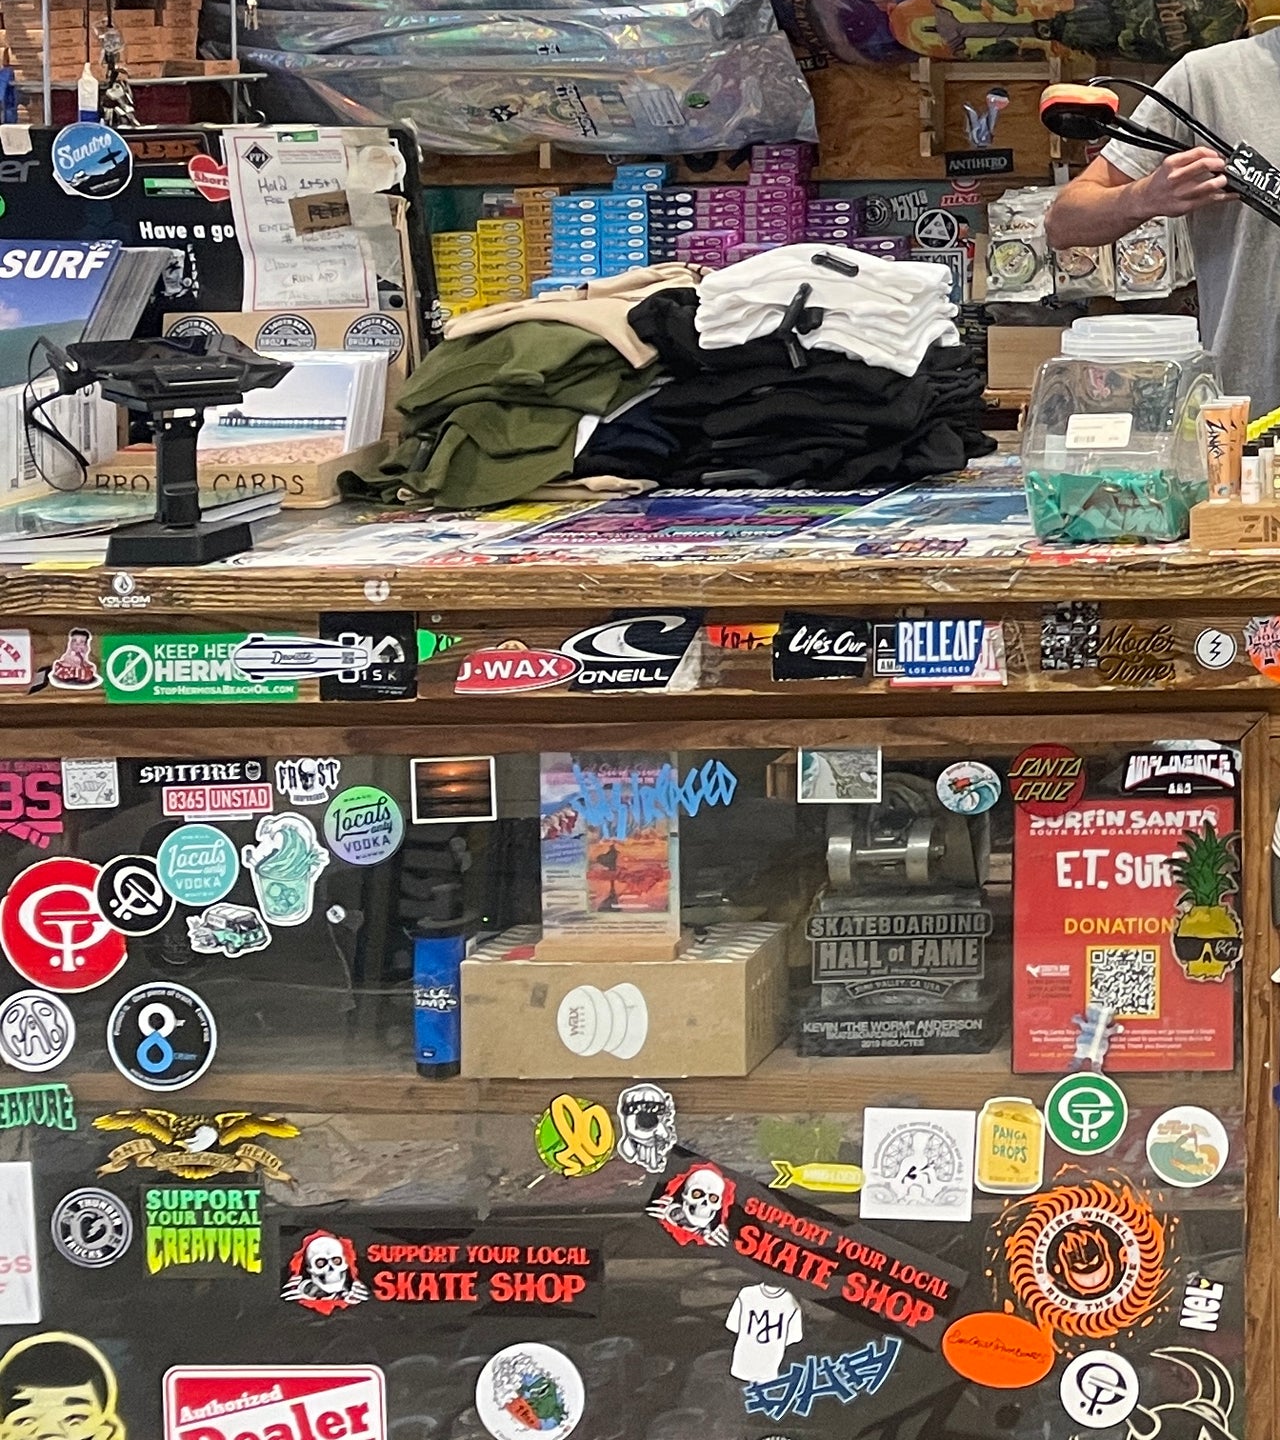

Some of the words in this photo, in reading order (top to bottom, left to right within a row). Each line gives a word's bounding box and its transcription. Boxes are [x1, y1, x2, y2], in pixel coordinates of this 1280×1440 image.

[948, 156, 1008, 171] ANTIHERO
[138, 220, 187, 240] Have
[194, 226, 206, 239] a
[210, 224, 235, 244] go
[3, 243, 119, 279] SURF
[286, 338, 312, 347] PHOTO
[212, 473, 305, 497] CARDS
[98, 595, 150, 605] VOLCOM
[154, 643, 196, 659] KEEP
[898, 620, 982, 662] RELEAF
[908, 665, 924, 674] LOS
[927, 664, 969, 674] ANGELES
[139, 762, 242, 783] SPITFIRE
[1007, 756, 1083, 778] SANTA
[168, 788, 206, 811] 8365
[210, 786, 269, 810] UNSTAD
[1013, 778, 1074, 803] CRUZ
[343, 835, 390, 851] VODKA
[167, 844, 226, 871] Locals
[1056, 849, 1110, 890] E.T.
[176, 877, 222, 888] VODKA
[811, 913, 986, 937] SKATEBOARDING
[820, 941, 882, 969] HALL
[888, 947, 905, 961] of
[910, 939, 979, 967] FAME
[803, 1022, 838, 1032] KEVIN
[917, 1019, 983, 1030] ANDERSON
[990, 1143, 1028, 1165] DROPS
[146, 1189, 257, 1211] SUPPORT
[147, 1211, 197, 1226] YOUR
[202, 1211, 262, 1226] LOCAL
[146, 1226, 262, 1275] CREATURE
[367, 1245, 462, 1265] SUPPORT
[466, 1245, 520, 1266] YOUR
[526, 1245, 590, 1266] LOCAL
[743, 1197, 831, 1247] SUPPORT
[836, 1236, 889, 1274] YOUR
[889, 1257, 950, 1302] LOCAL
[373, 1272, 477, 1303] SKATE
[489, 1272, 587, 1304] SHOP
[733, 1226, 832, 1291] SKATE
[841, 1272, 936, 1328] SHOP
[180, 1383, 282, 1423] Authorized
